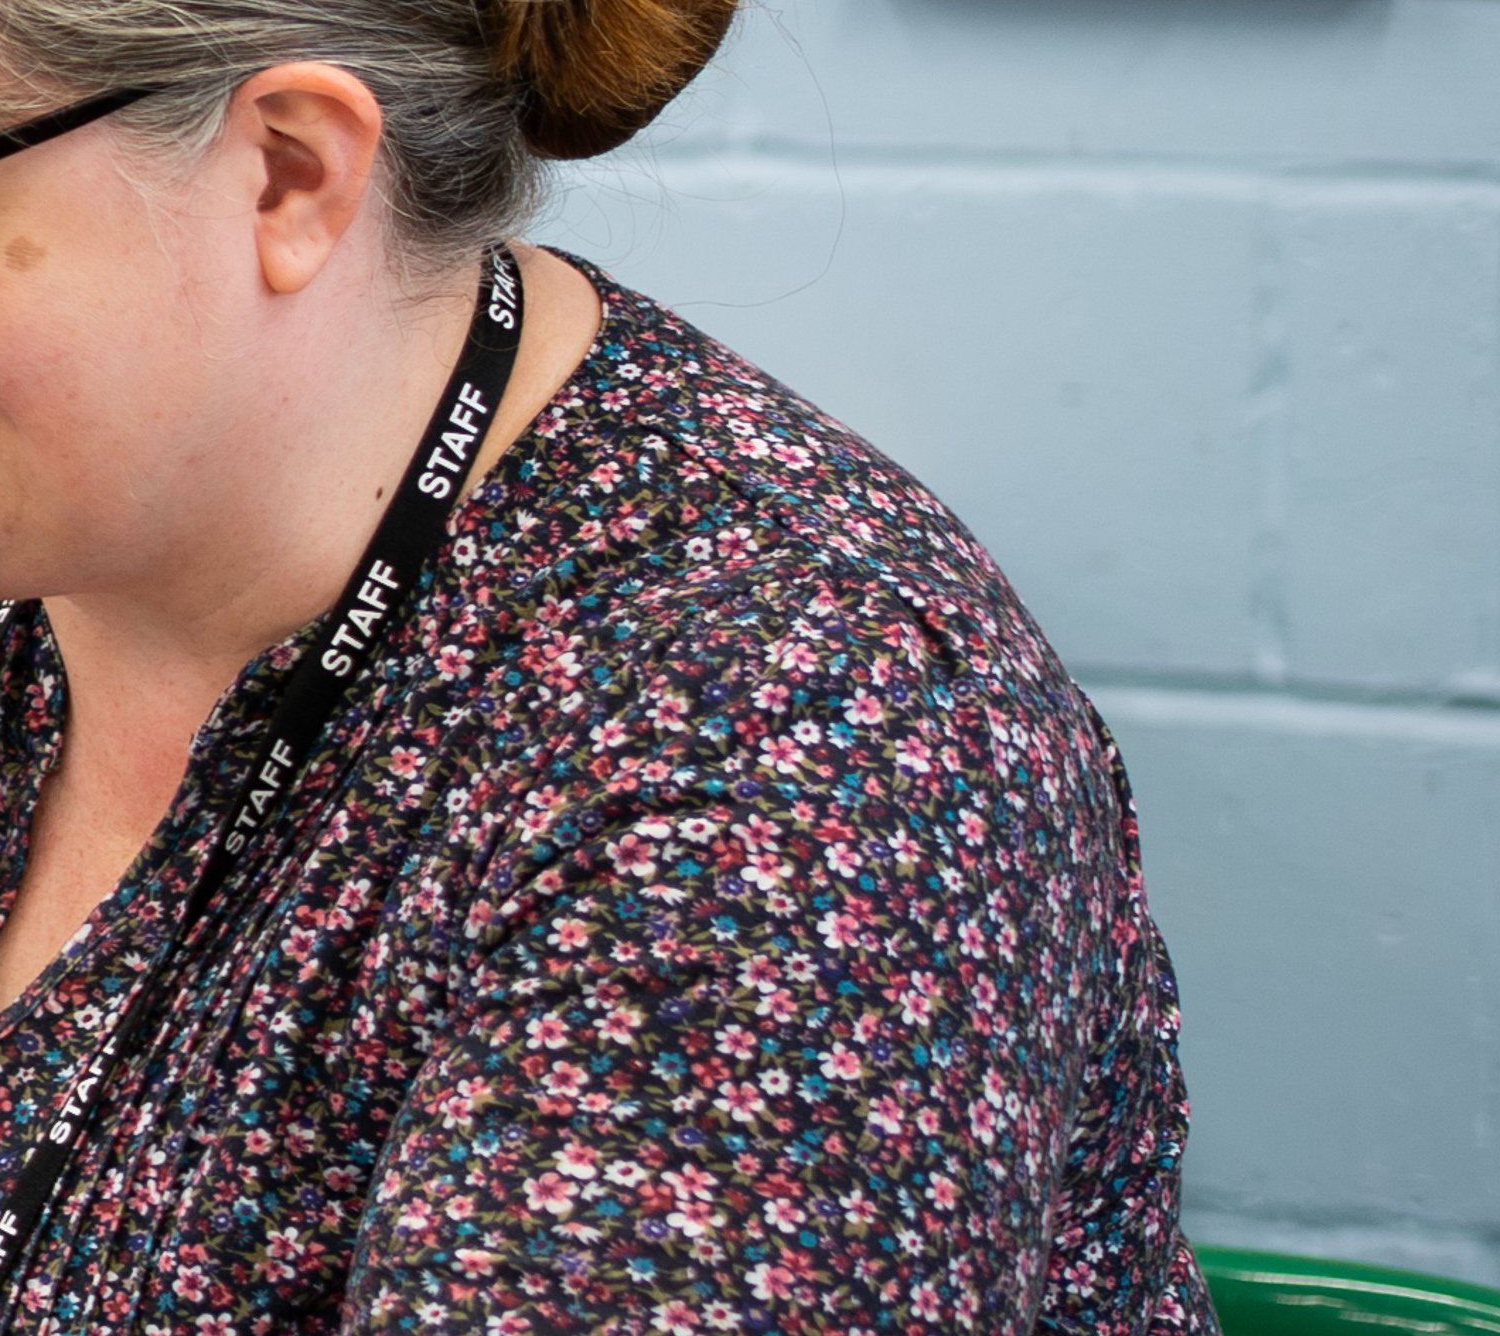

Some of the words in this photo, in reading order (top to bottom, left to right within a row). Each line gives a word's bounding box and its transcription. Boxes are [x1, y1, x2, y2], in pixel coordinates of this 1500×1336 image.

[487, 245, 516, 330] STAFF
[417, 382, 488, 500] STAFF
[321, 560, 399, 677] STAFF
[225, 739, 293, 855] STAFF
[49, 1036, 117, 1144] STAFF
